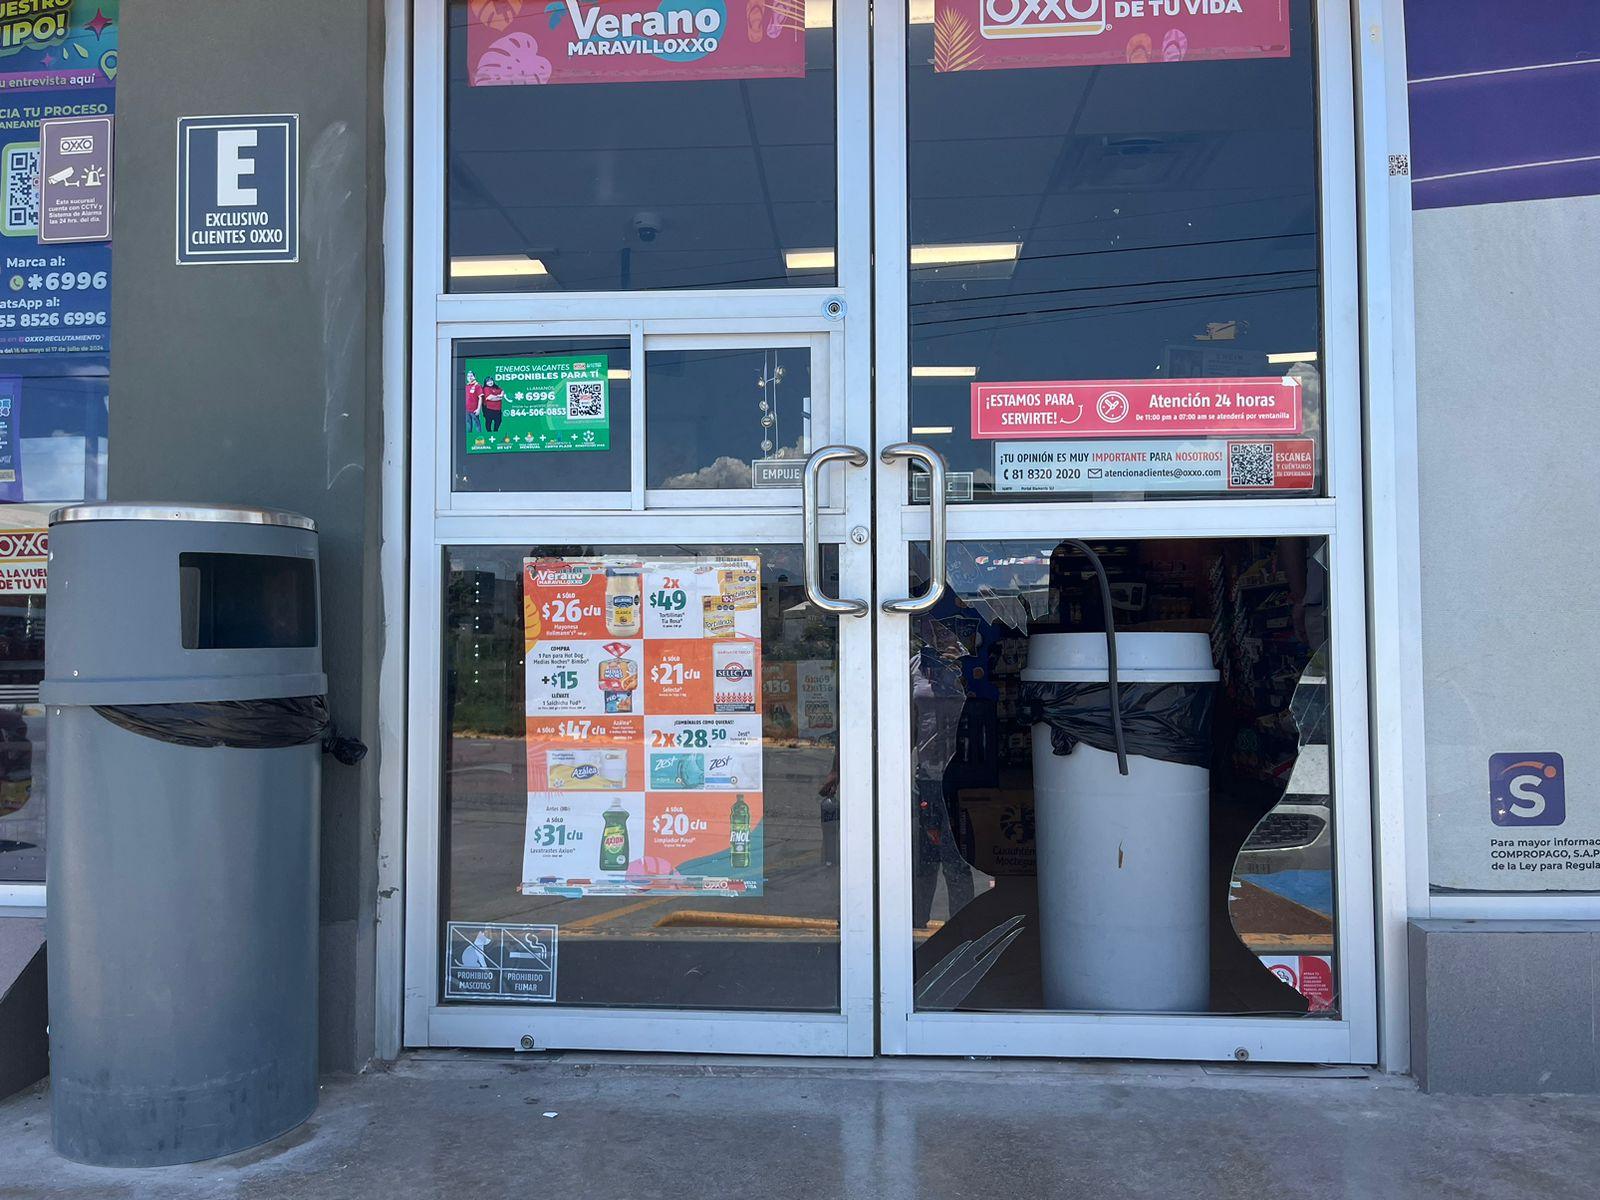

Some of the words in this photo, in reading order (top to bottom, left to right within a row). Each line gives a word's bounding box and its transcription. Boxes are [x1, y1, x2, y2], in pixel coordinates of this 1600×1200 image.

[1114, 1, 1145, 18] DE
[1148, 0, 1181, 17] TU
[1184, 0, 1243, 15] VIDA
[567, 0, 720, 39] Verano
[568, 37, 718, 56] MARAVILLOXXO
[9, 76, 67, 88] entrevista
[70, 73, 96, 85] aquí
[23, 107, 40, 118] TU
[44, 103, 108, 117] PROCESO
[61, 139, 93, 152] OXXO
[217, 129, 258, 207] E
[205, 211, 269, 227] EXCLUSIVO
[192, 229, 246, 245] CLIENTES
[250, 229, 283, 244] OXXO
[6, 257, 47, 268] Marca
[50, 255, 66, 267] al:
[46, 297, 60, 308] al:
[20, 313, 60, 327] 8526
[63, 312, 107, 326] 6996
[495, 365, 530, 373] TENEMOS
[532, 363, 570, 372] VACANTES
[495, 372, 559, 381] DISPONIBLES
[561, 371, 587, 379] PARA
[986, 393, 1041, 409] ¡ESTAMOS
[1045, 393, 1075, 406] PARA
[1149, 393, 1210, 409] Atención
[1215, 394, 1231, 407] 24
[1236, 393, 1276, 407] horas
[1001, 412, 1058, 425] SERVIRTE!
[1217, 412, 1245, 420] atenderá
[1246, 413, 1257, 421] por
[1258, 411, 1290, 419] ventanilla
[1000, 454, 1014, 465] ¡TU
[1017, 451, 1054, 463] OPINIÓN
[1057, 453, 1067, 463] ES
[1070, 453, 1089, 462] MUY
[1092, 452, 1147, 462] IMPORTANTE
[1150, 452, 1172, 461] PARA
[1175, 451, 1223, 461] NOSOTROS!
[1275, 452, 1312, 462] ESCANEA
[762, 468, 800, 480] EMPUJE
[1012, 469, 1023, 480] 81
[1027, 469, 1052, 480] 8320
[1056, 468, 1081, 479] 2020
[1104, 468, 1221, 479] atencionaclientes@oxxo.com
[7, 569, 21, 578] LA
[15, 579, 31, 589] TU
[663, 576, 680, 589] 2x
[649, 590, 687, 611] $49
[558, 720, 592, 740] $47
[591, 725, 606, 736] c/u
[651, 729, 675, 748] 2x
[1509, 774, 1546, 818] S
[533, 824, 566, 847] $31
[566, 830, 584, 841] c/u
[1490, 839, 1514, 847] Para
[1517, 840, 1551, 849] mayor
[1554, 837, 1600, 846] informac
[1490, 850, 1571, 860] COMPROPAGO,
[1491, 862, 1505, 870] de
[1507, 861, 1517, 870] la
[1519, 861, 1537, 872] Ley
[1540, 863, 1563, 872] para
[457, 971, 493, 980] PROHIBIDO
[507, 972, 543, 982] PROHIBIDO
[459, 981, 491, 990] MASCOTAS
[515, 982, 538, 991] FUMAR
